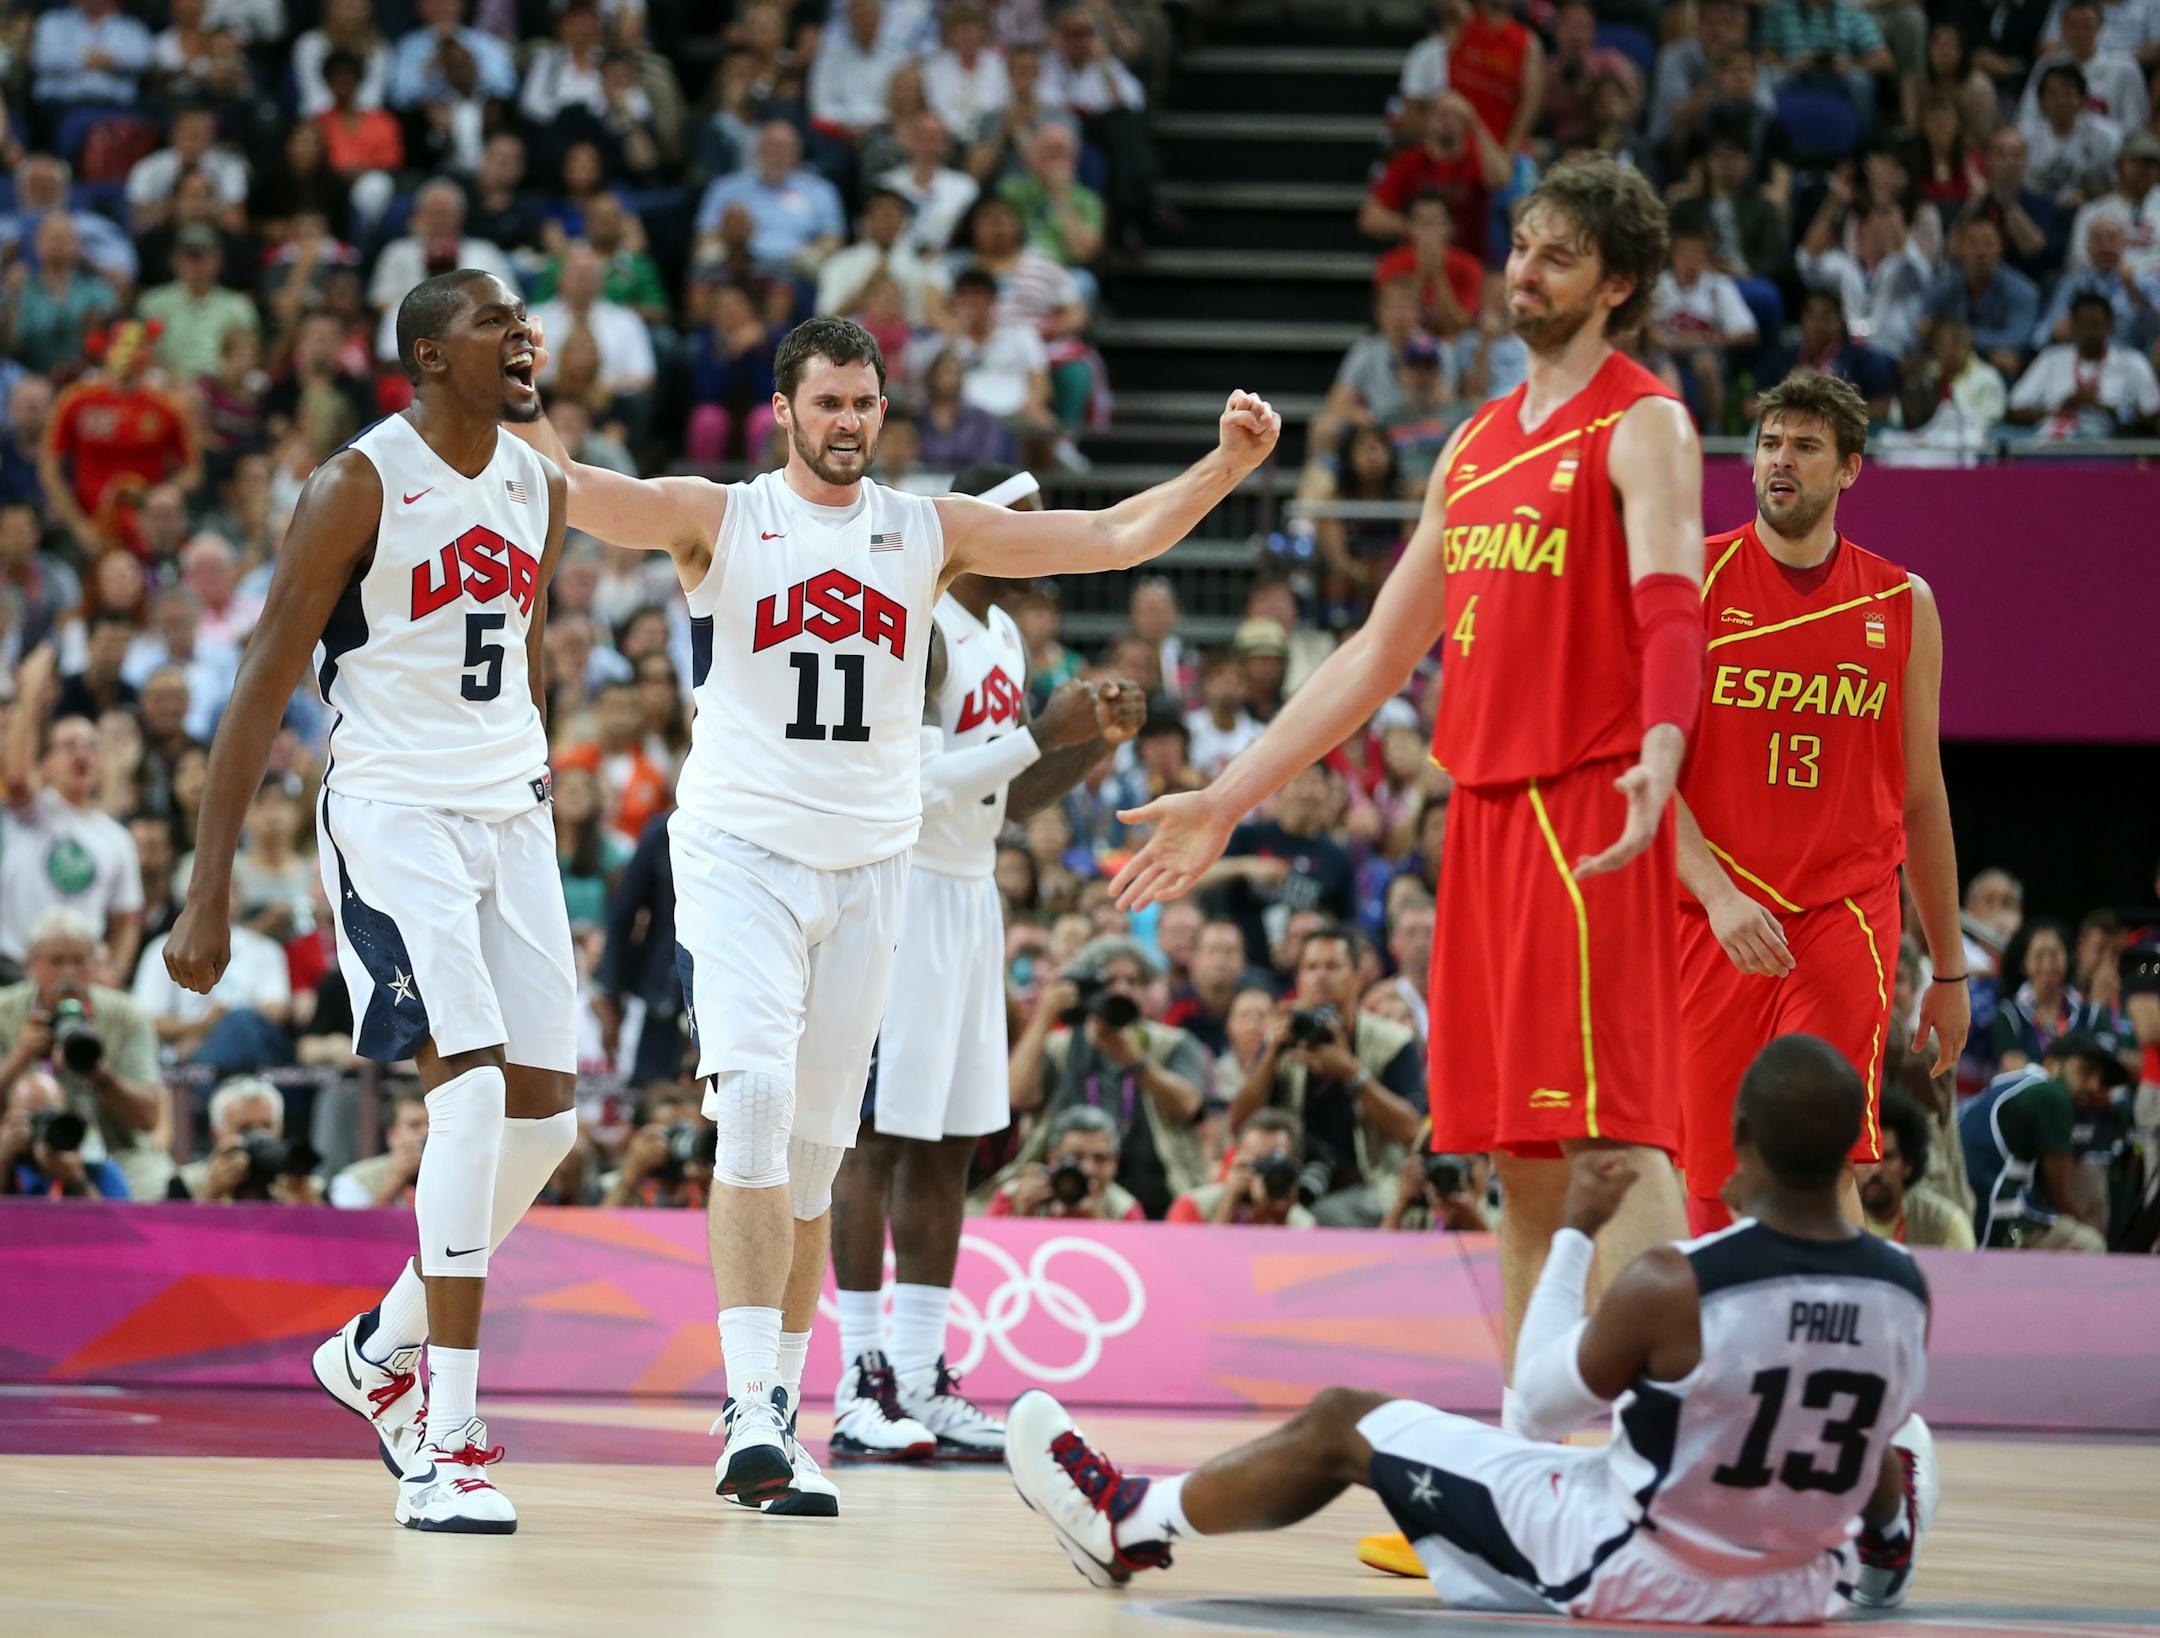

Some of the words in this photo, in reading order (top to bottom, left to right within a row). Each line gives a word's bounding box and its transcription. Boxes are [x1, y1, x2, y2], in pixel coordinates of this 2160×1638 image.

[411, 524, 539, 622] USA
[753, 569, 907, 661] USA
[461, 613, 506, 701] 5
[1452, 594, 1480, 657] 4
[786, 652, 871, 741] 11
[1711, 662, 1888, 720] ESPAÑA
[1767, 732, 1821, 789] 13
[1788, 1301, 1862, 1346] PAUL
[1711, 1366, 1888, 1495] 13
